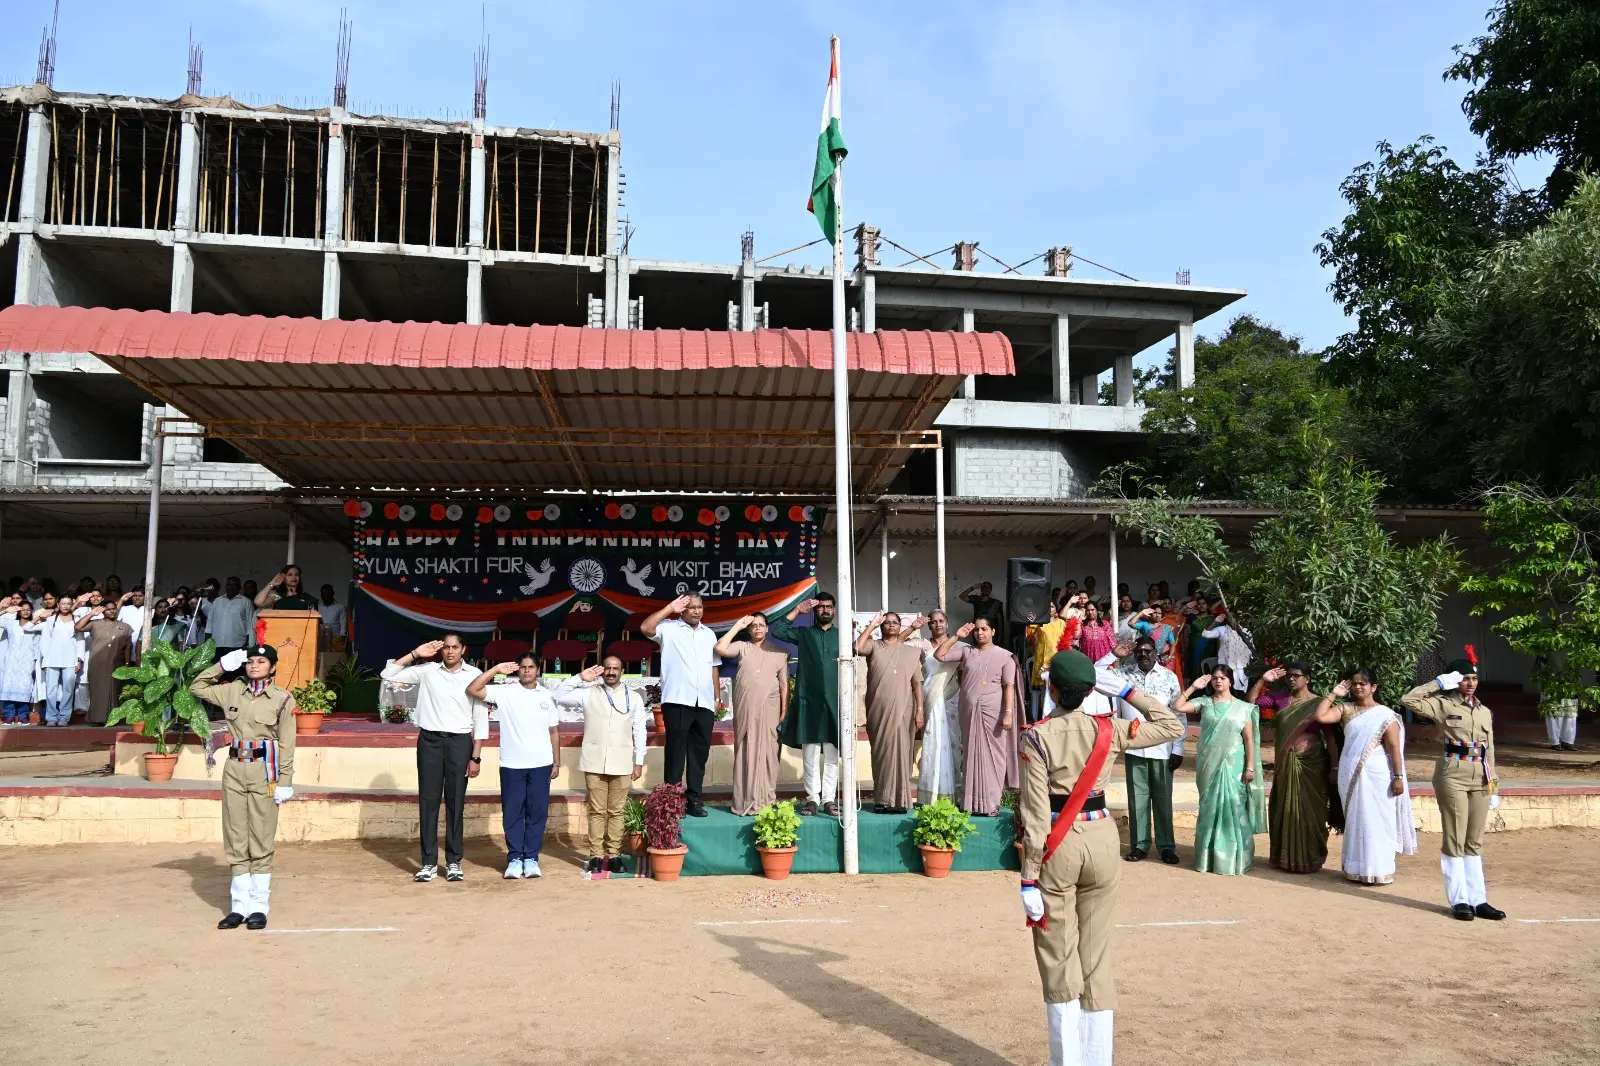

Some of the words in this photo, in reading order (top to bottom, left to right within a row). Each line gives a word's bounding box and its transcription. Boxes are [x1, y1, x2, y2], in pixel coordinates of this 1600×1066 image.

[365, 528, 461, 553] HAPPY
[494, 528, 710, 554] INDEPENDENCE
[735, 530, 789, 555] DAY
[364, 557, 409, 575] YUVA
[415, 557, 479, 574] SHAKTI
[486, 556, 524, 574] FOR
[658, 560, 710, 578] VIKSIT
[720, 561, 784, 579] BHARAT
[697, 579, 748, 597] 2047
